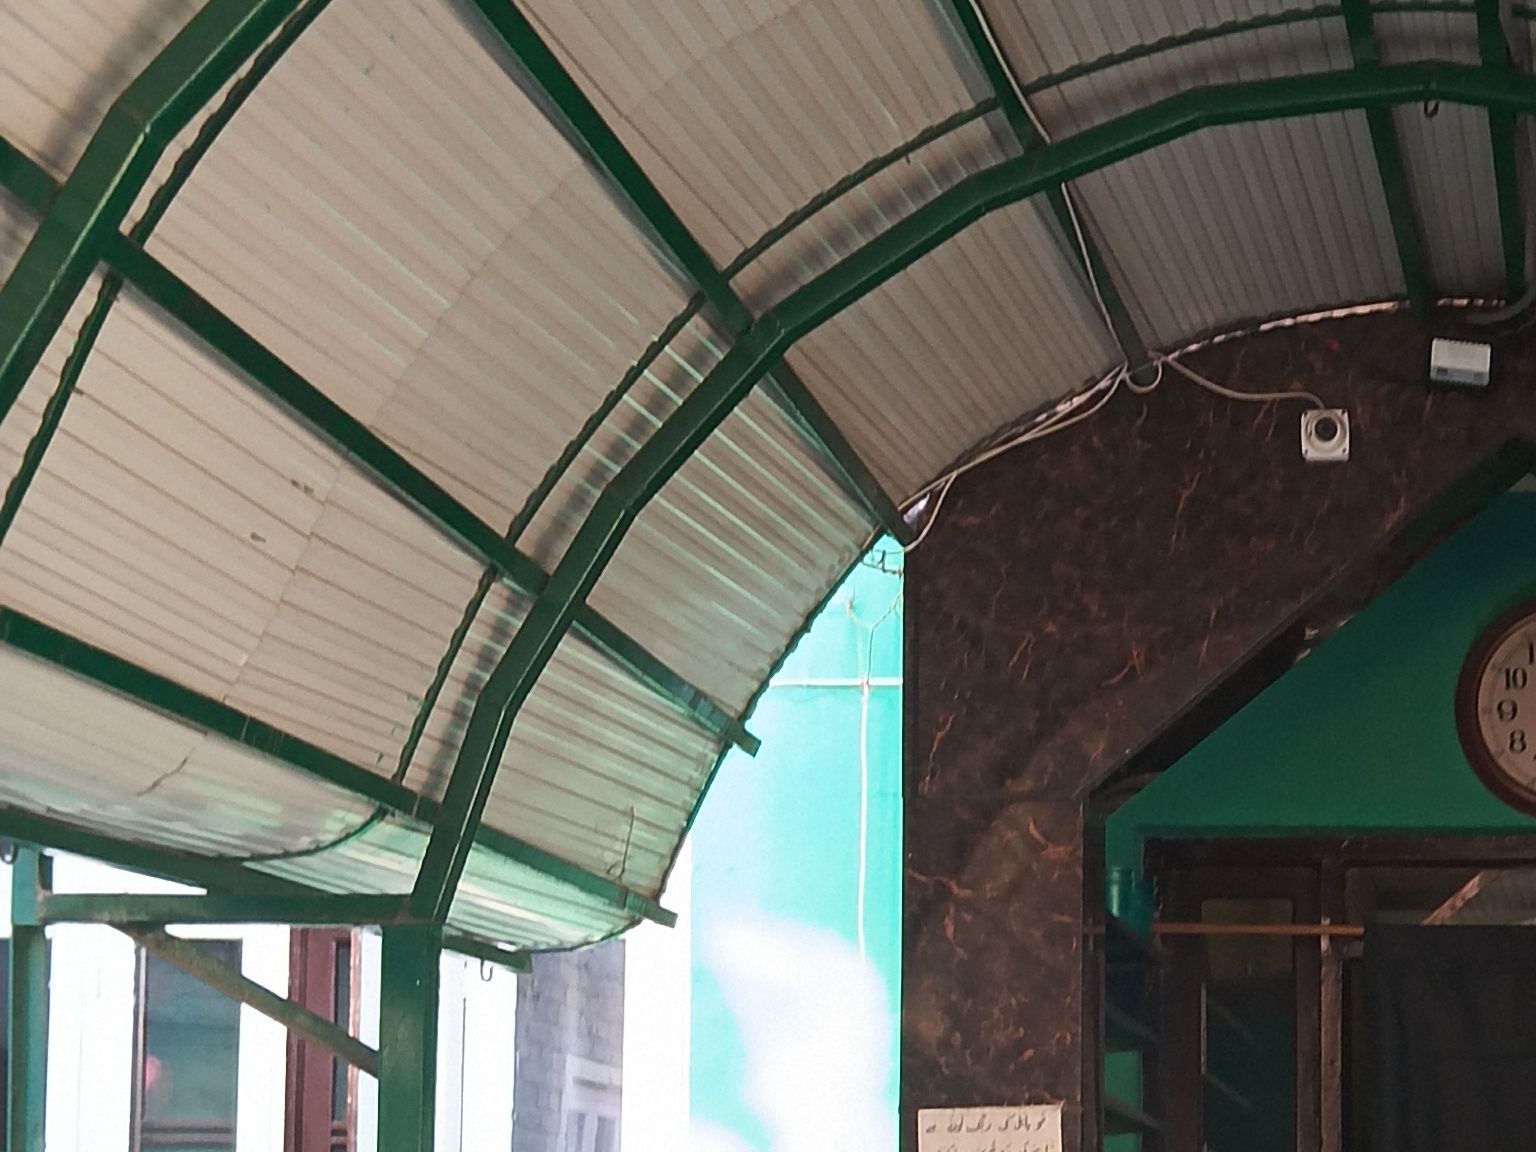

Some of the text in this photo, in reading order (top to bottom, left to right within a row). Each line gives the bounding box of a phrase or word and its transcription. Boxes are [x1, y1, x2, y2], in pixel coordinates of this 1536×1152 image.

[1504, 667, 1527, 690] 10
[1497, 699, 1518, 722] 9
[1509, 729, 1527, 754] 8
